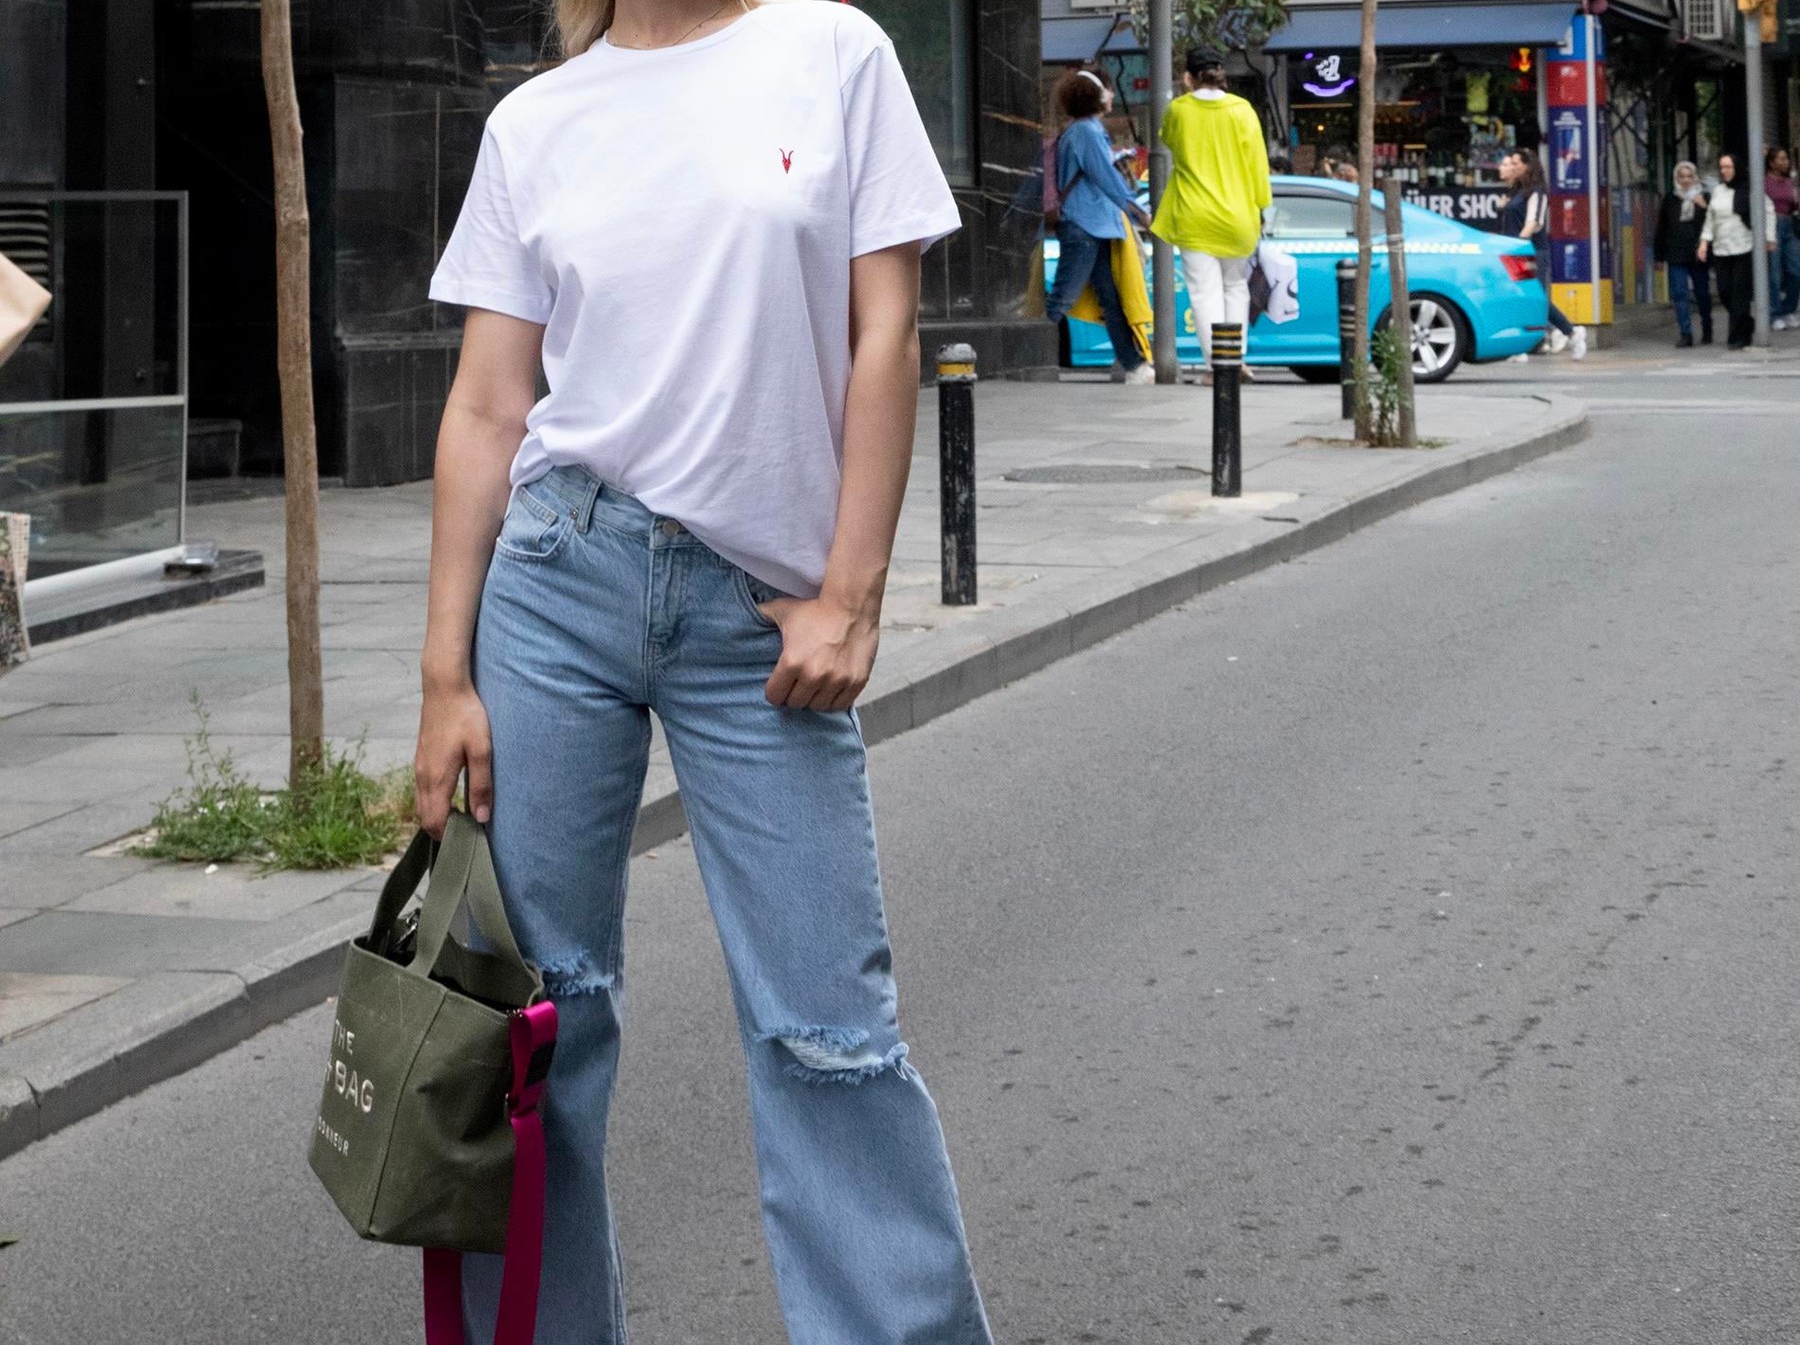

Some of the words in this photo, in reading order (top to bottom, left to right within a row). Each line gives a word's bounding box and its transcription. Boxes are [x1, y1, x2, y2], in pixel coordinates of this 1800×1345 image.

[1458, 194, 1506, 219] SHO
[334, 1019, 355, 1055] THE
[335, 1059, 374, 1113] BAG
